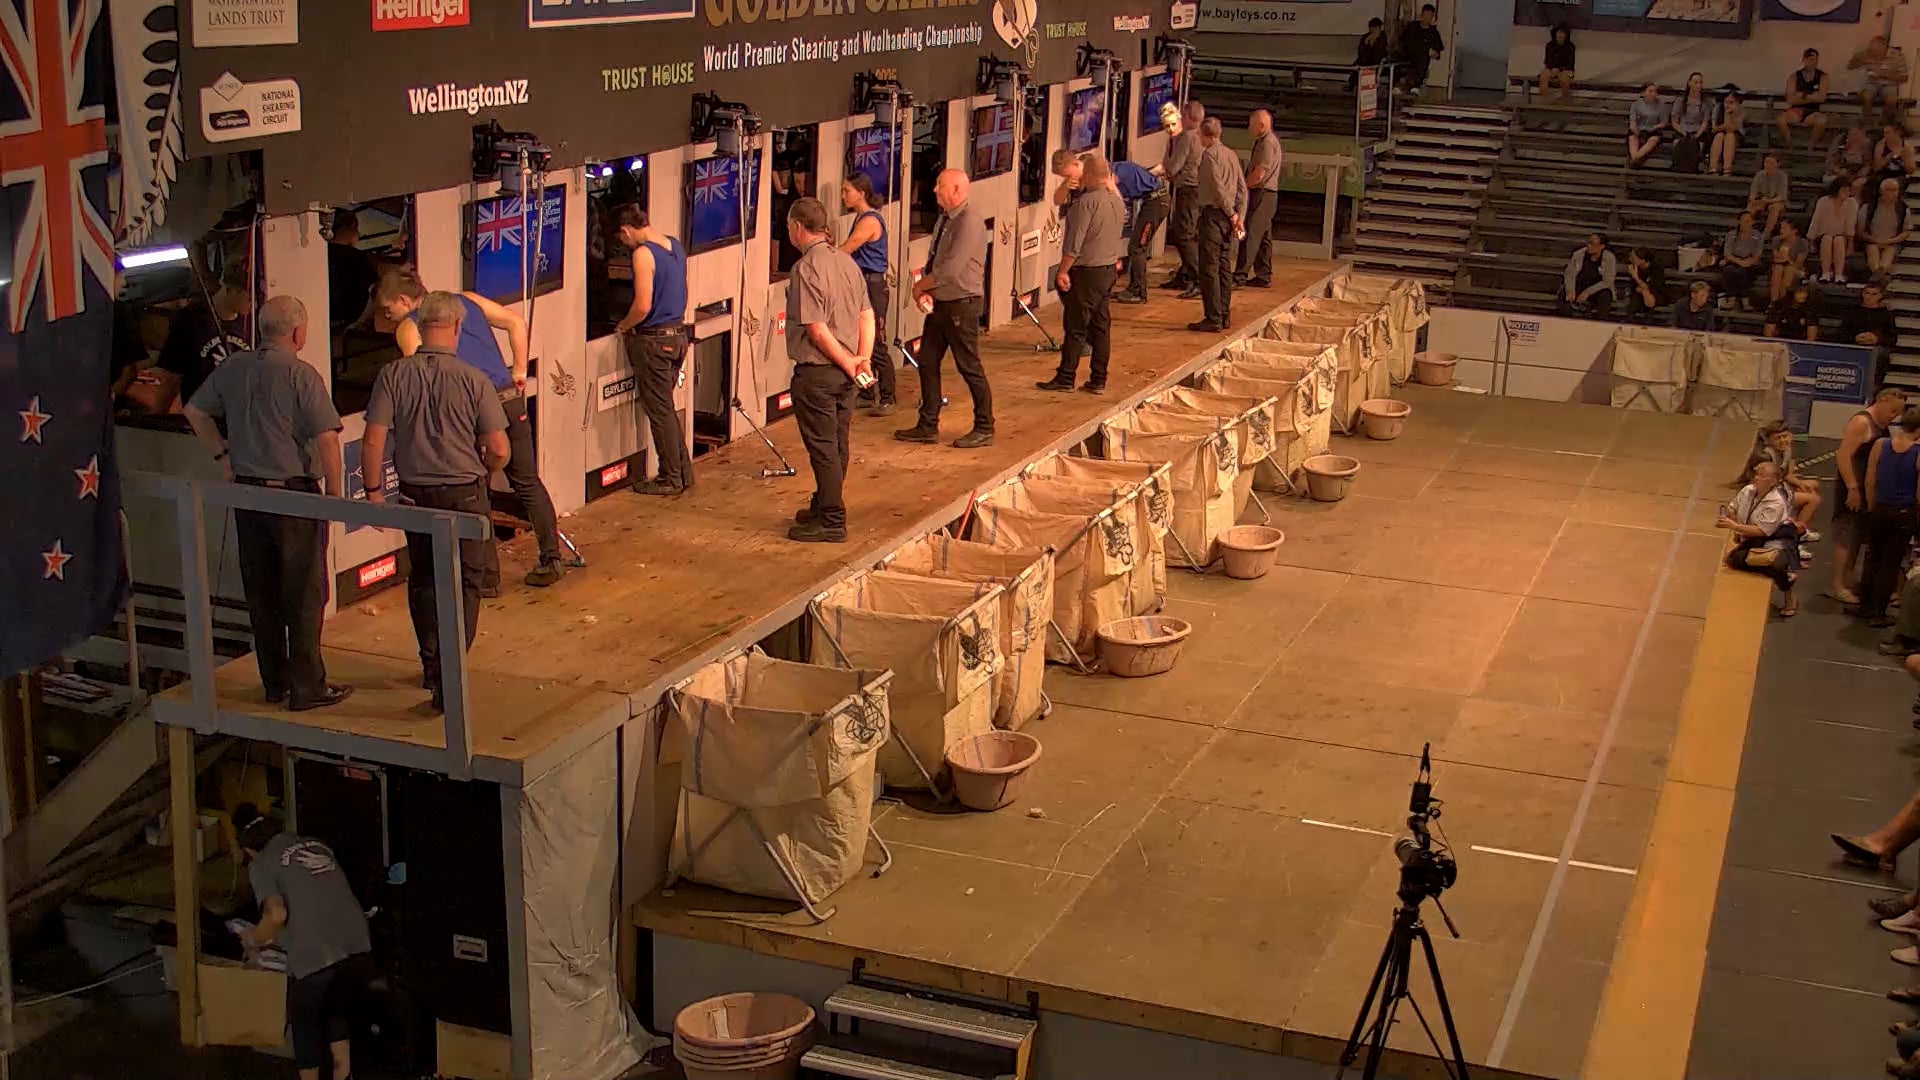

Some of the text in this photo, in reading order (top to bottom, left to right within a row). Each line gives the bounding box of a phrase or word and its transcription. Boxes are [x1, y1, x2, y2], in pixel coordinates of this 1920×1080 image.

[208, 9, 286, 25] LANDS TRUST
[1199, 8, 1296, 22] w.bayleys.co.nz
[703, 21, 982, 73] World Premier Shearing and Woolhandling Championship
[602, 62, 695, 91] TRUST HOUSE
[262, 89, 295, 101] NATIONAL
[408, 79, 529, 115] WellingtonNZ
[262, 113, 288, 125] CIRCUIT
